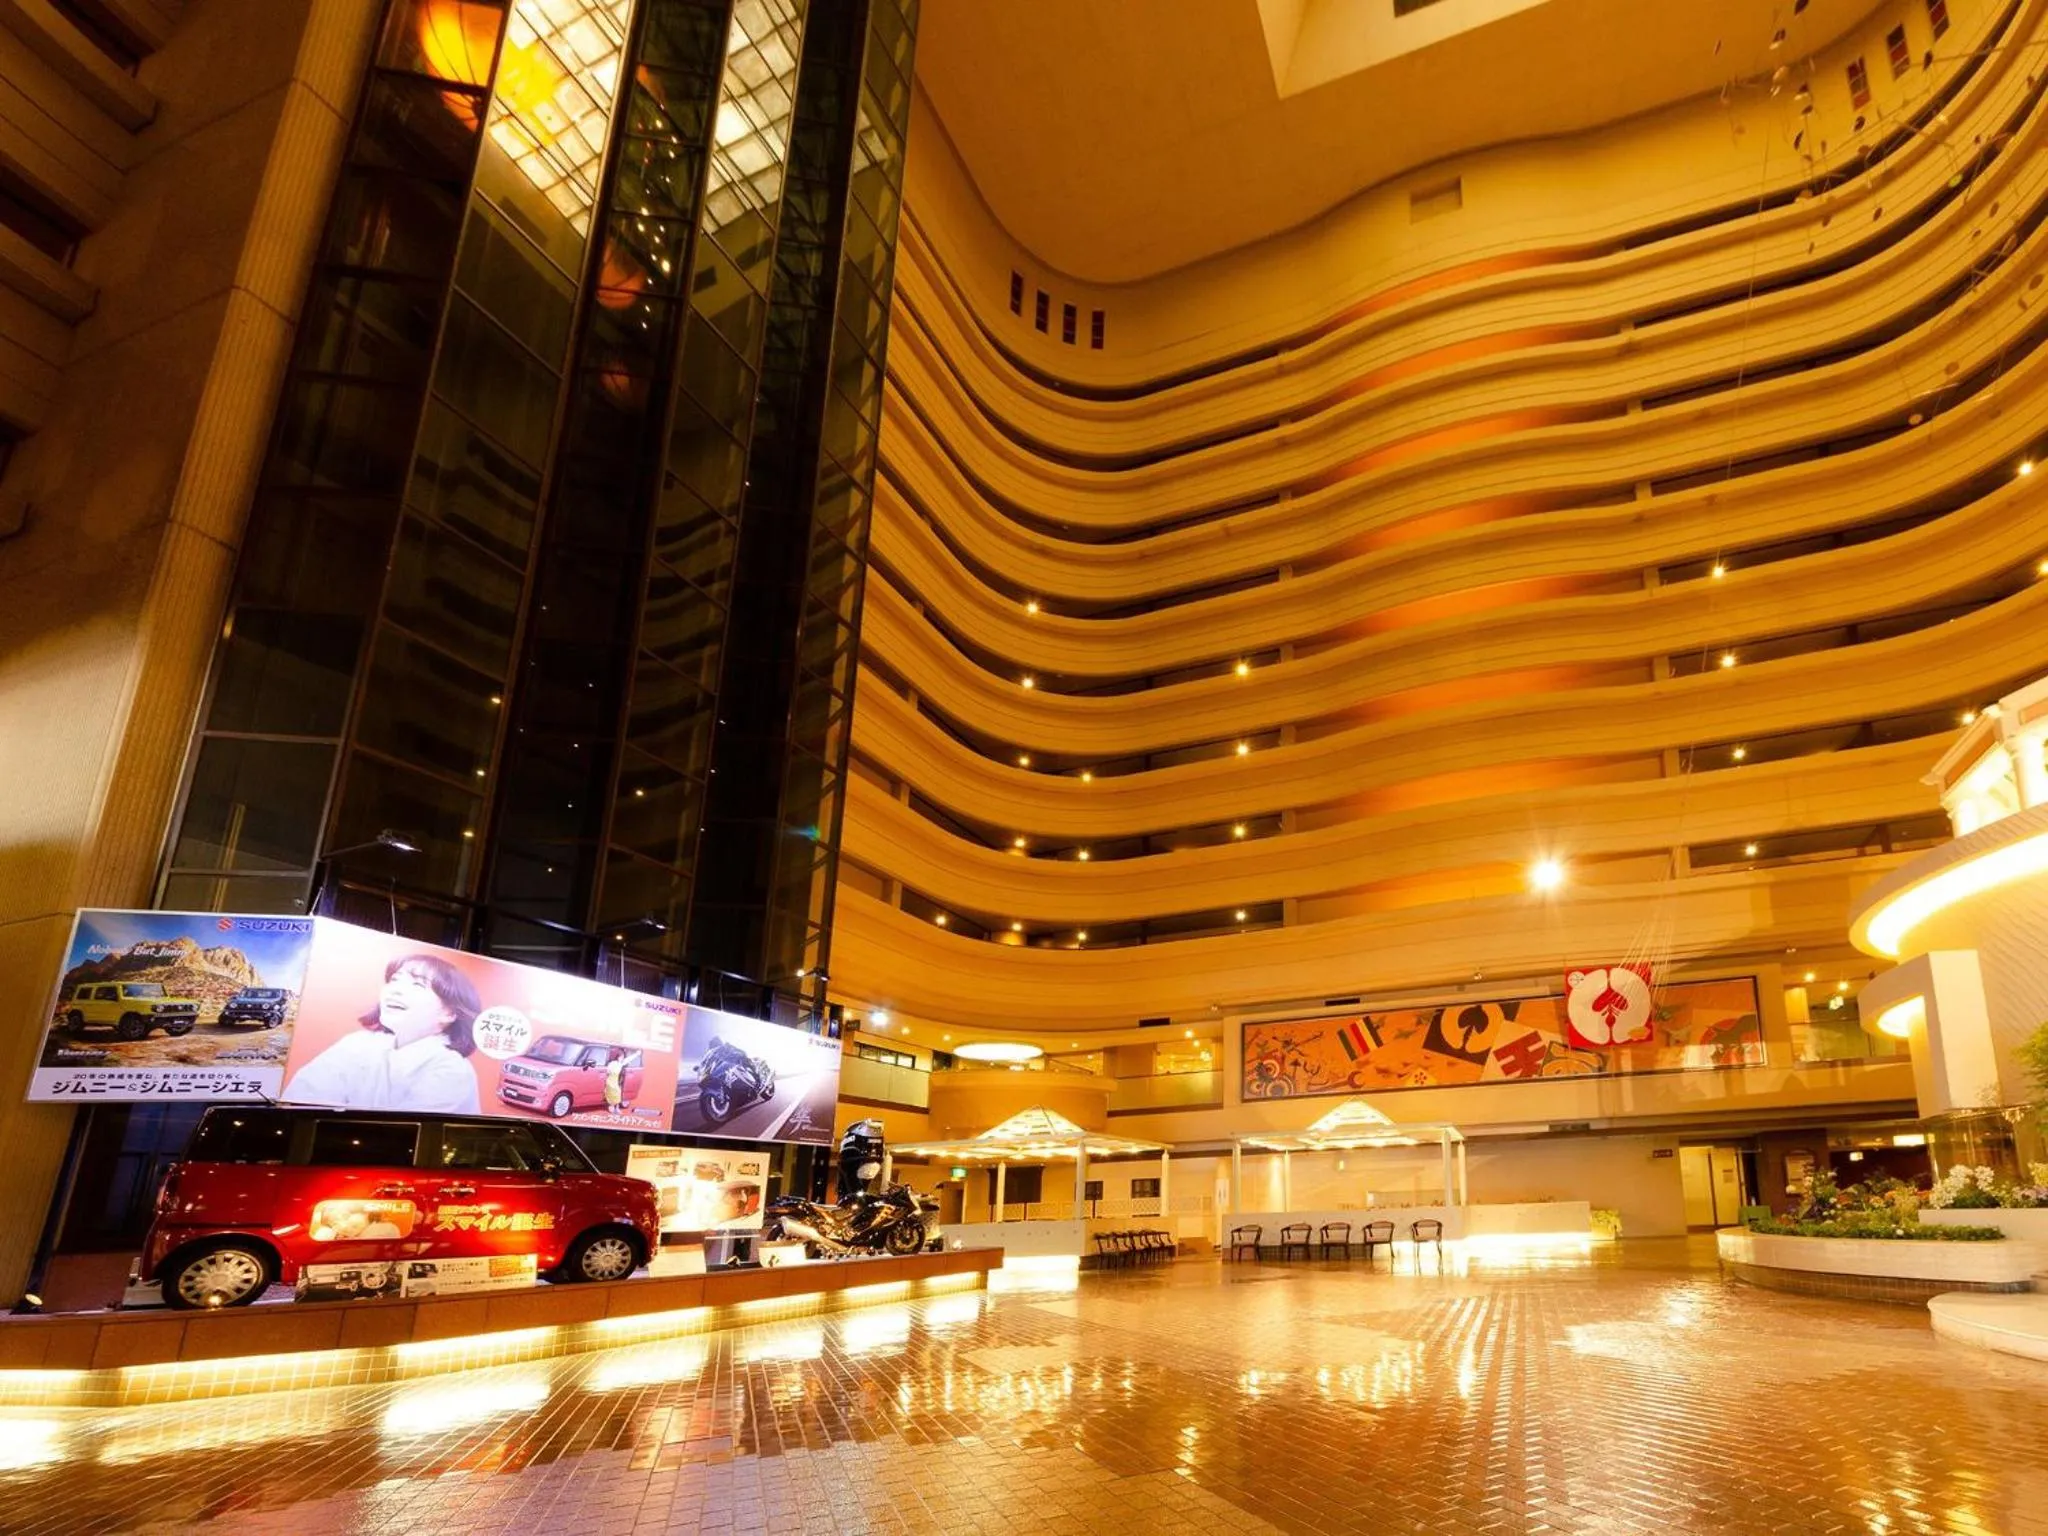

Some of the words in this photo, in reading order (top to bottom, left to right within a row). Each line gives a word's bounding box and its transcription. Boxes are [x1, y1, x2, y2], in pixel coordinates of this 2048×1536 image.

[238, 919, 312, 933] SUZUKI
[645, 1001, 681, 1015] SUZUKI
[480, 1020, 528, 1036] スマイル
